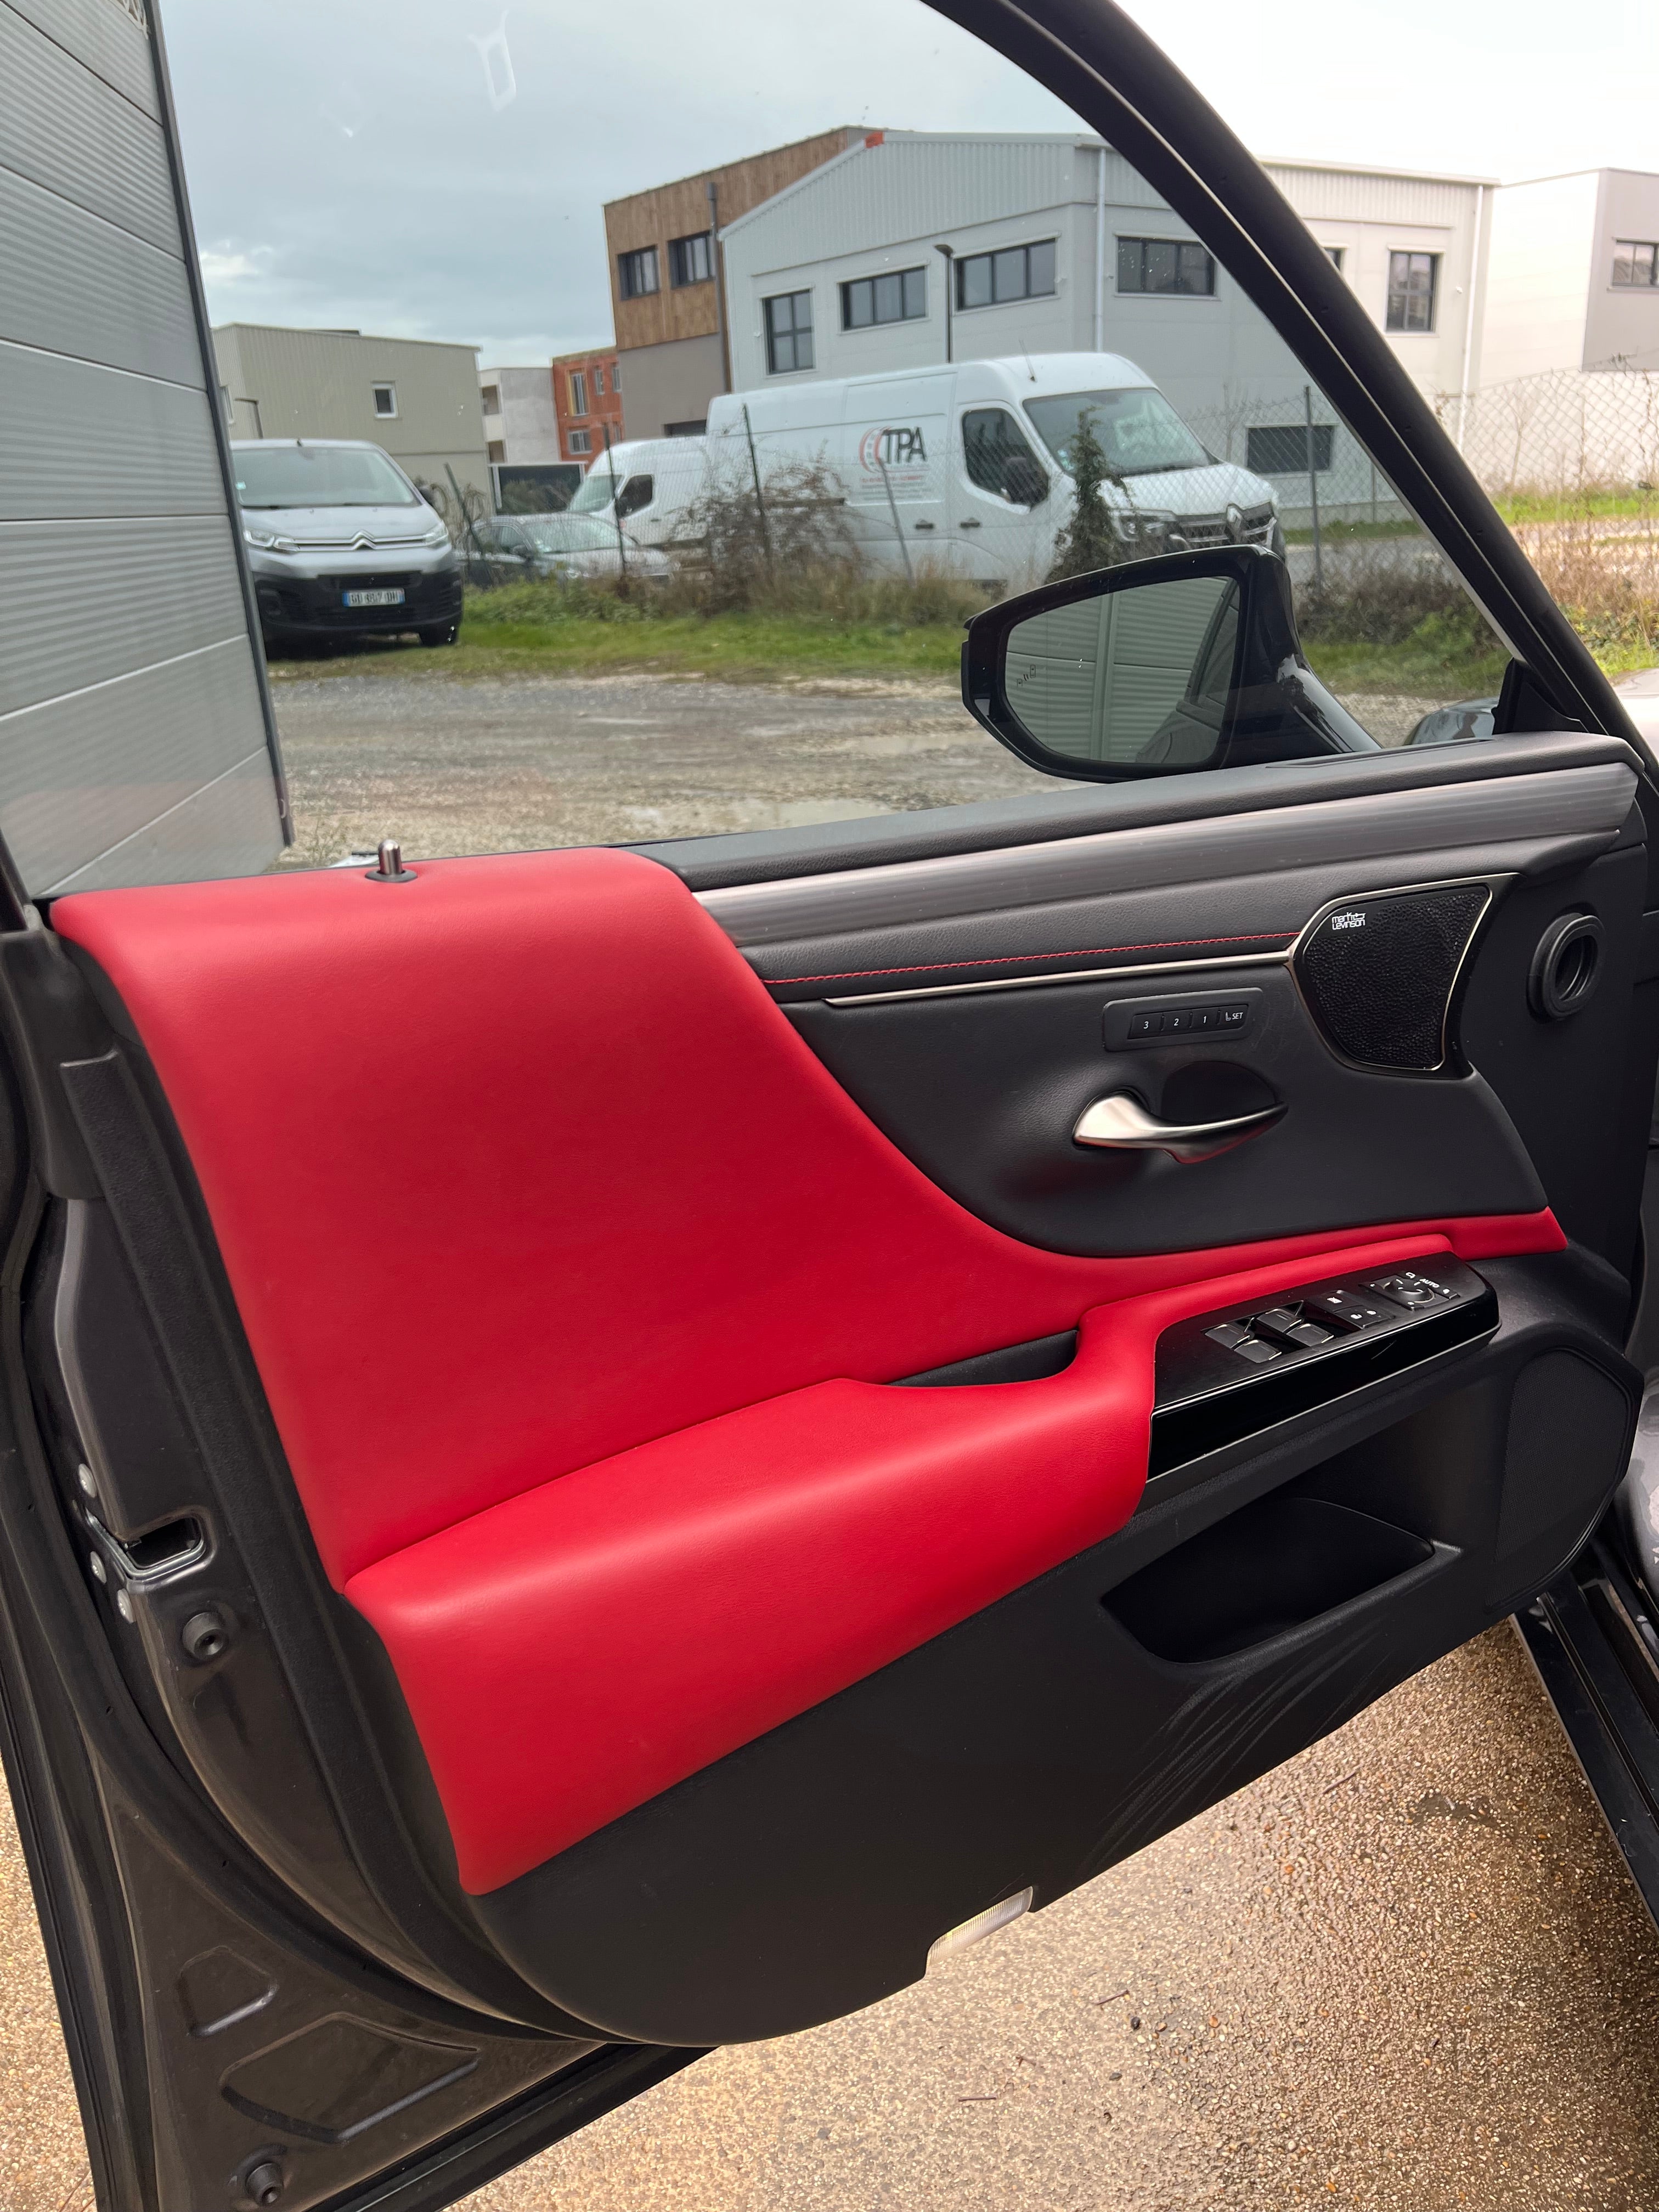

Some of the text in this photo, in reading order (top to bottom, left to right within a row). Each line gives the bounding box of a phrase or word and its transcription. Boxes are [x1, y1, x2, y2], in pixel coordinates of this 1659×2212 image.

[1143, 1021, 1149, 1029] 3
[1232, 1012, 1244, 1020] SET
[1419, 1278, 1440, 1288] AUTO
